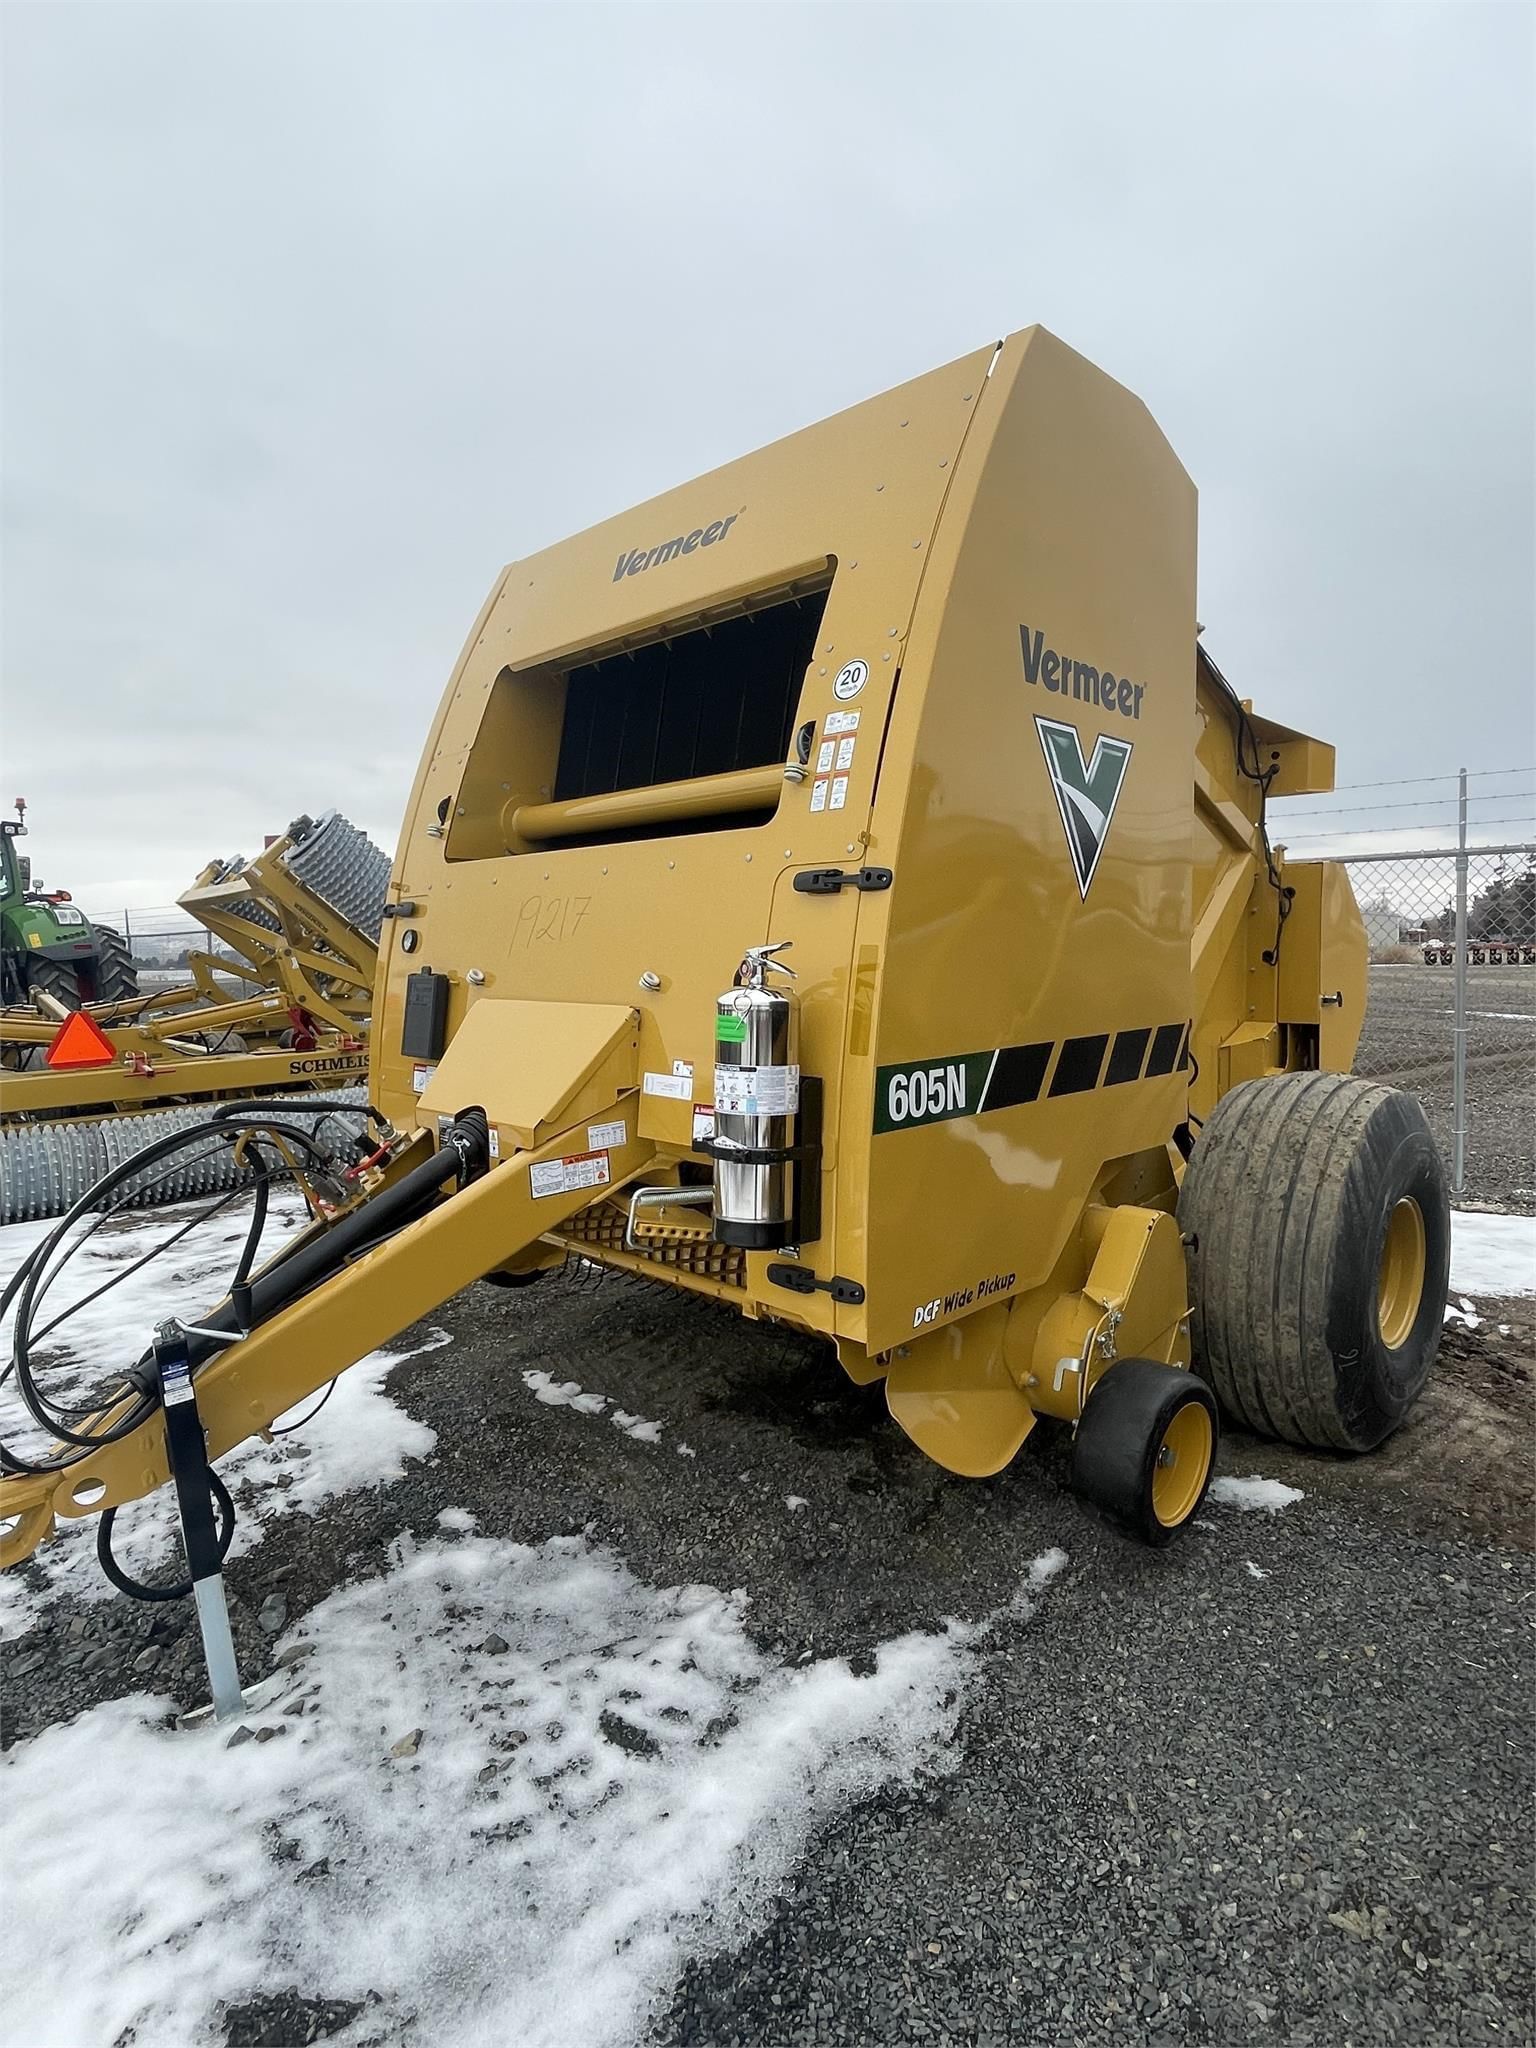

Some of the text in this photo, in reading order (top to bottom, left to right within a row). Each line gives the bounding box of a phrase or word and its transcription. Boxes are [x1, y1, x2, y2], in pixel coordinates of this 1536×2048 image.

[612, 513, 740, 583] Vermeer
[840, 667, 861, 686] 20
[1019, 624, 1145, 720] Vermeer
[888, 1064, 966, 1122] 605N
[912, 1273, 1016, 1329] DCF Wide Pickup
